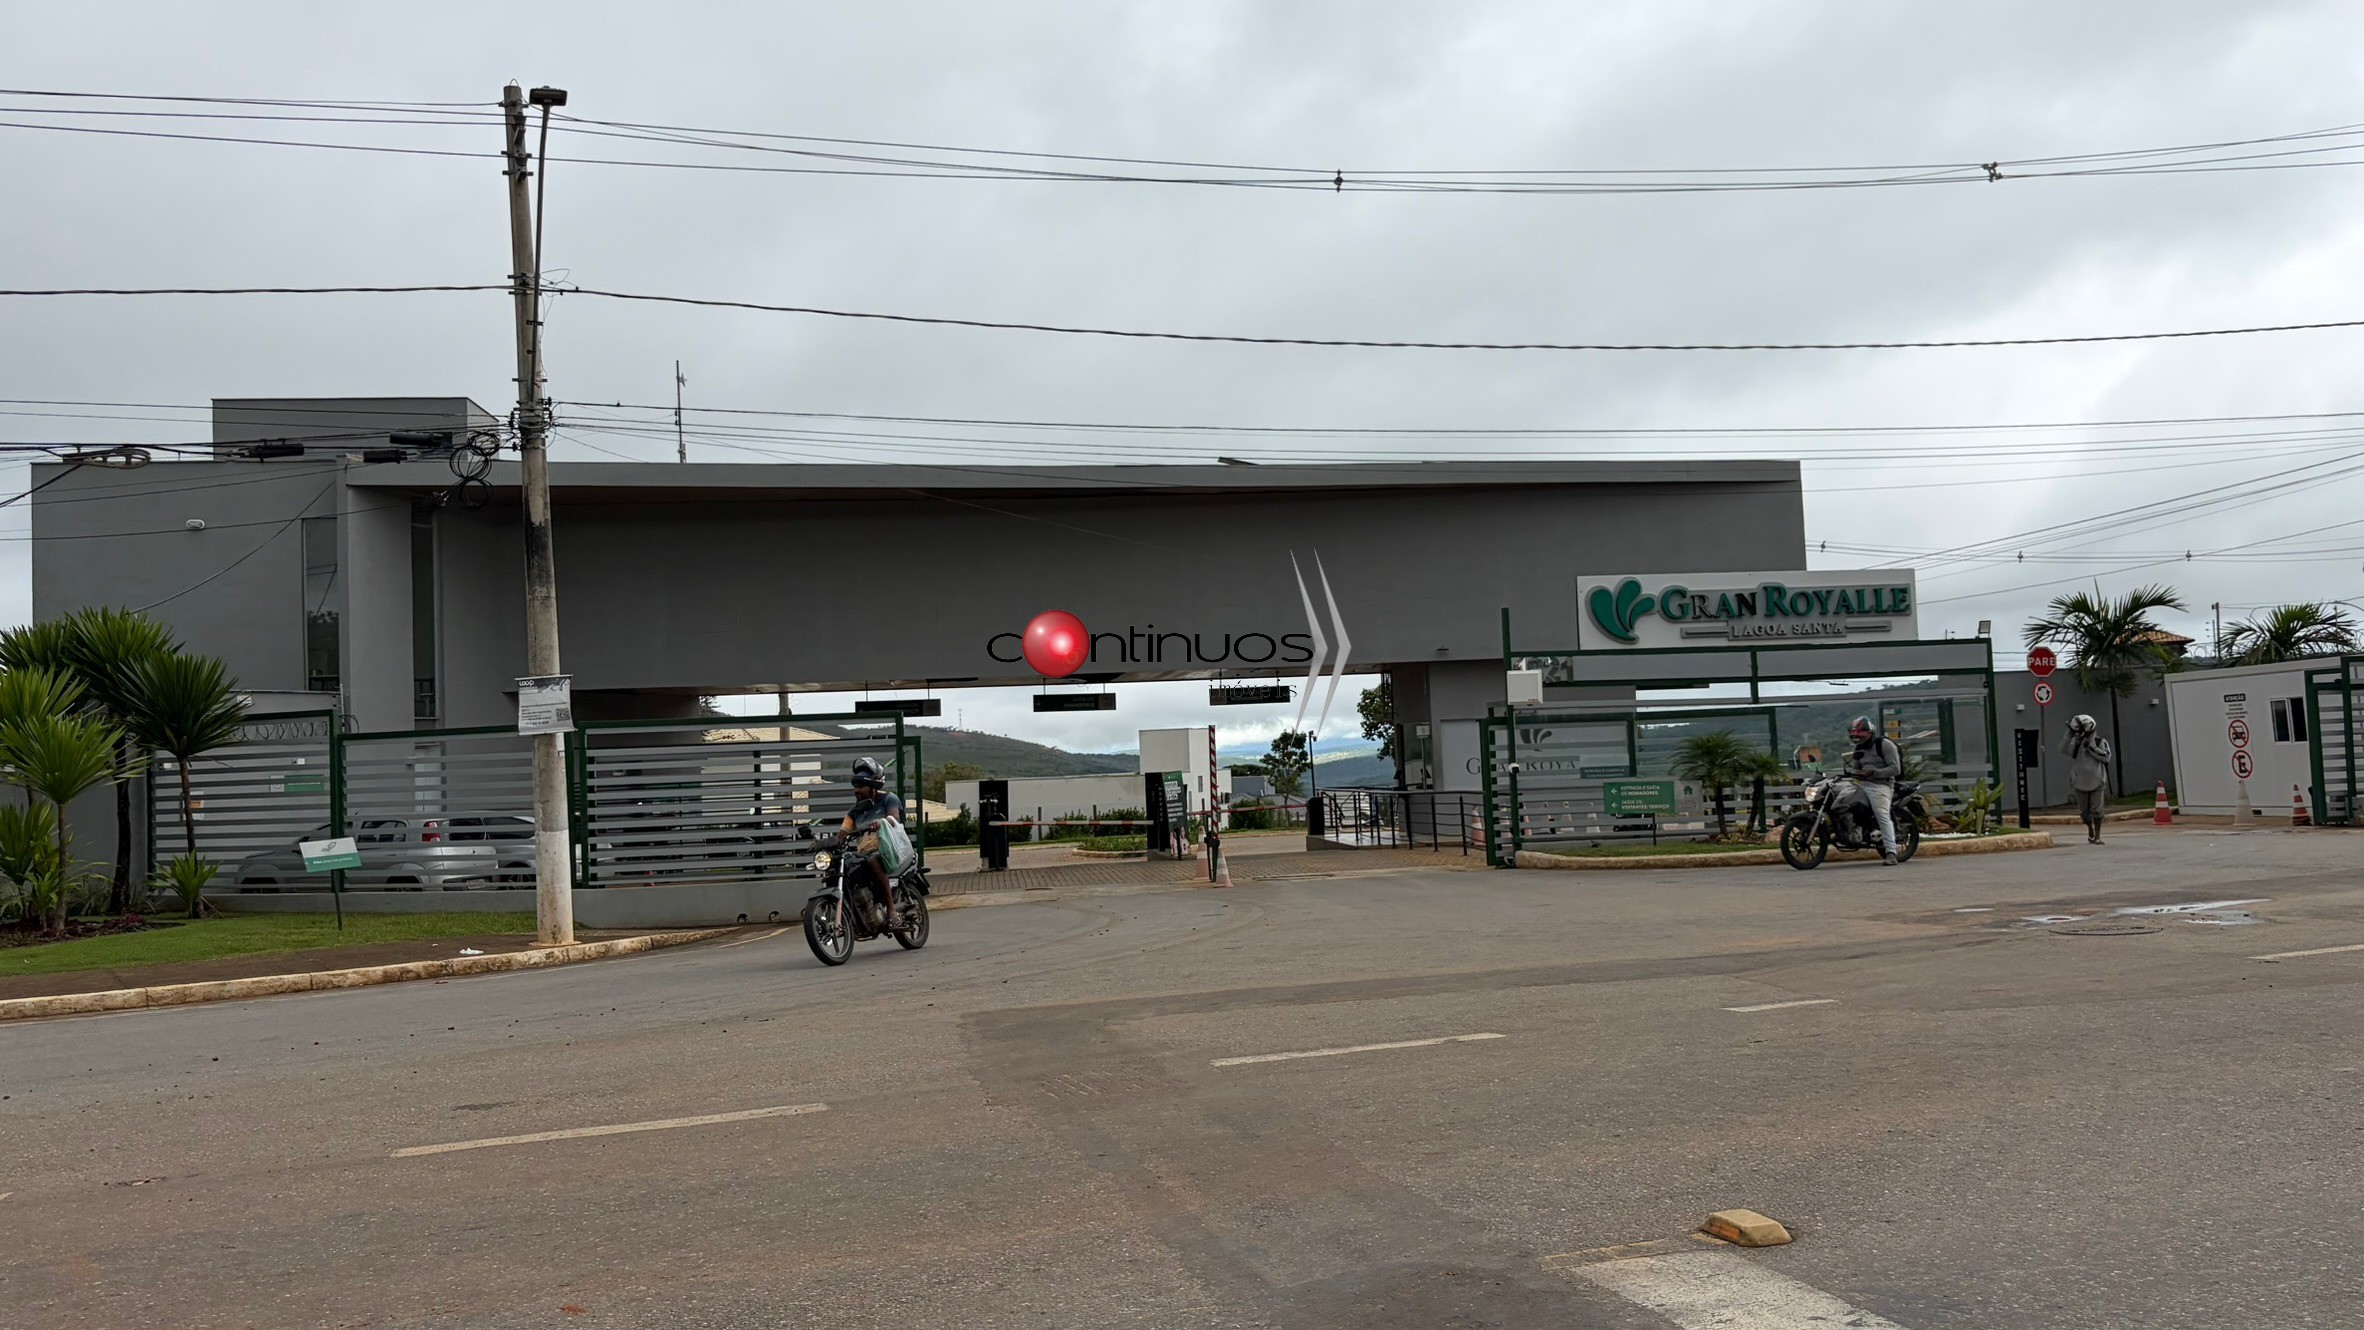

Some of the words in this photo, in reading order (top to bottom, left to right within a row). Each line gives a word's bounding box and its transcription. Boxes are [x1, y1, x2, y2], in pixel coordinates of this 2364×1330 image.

[1660, 585, 1757, 619] GRAN
[1763, 584, 1910, 617] ROYALLE
[1732, 624, 1787, 637] LAGOA
[1792, 622, 1843, 635] SANTA
[2028, 656, 2056, 667] PARE
